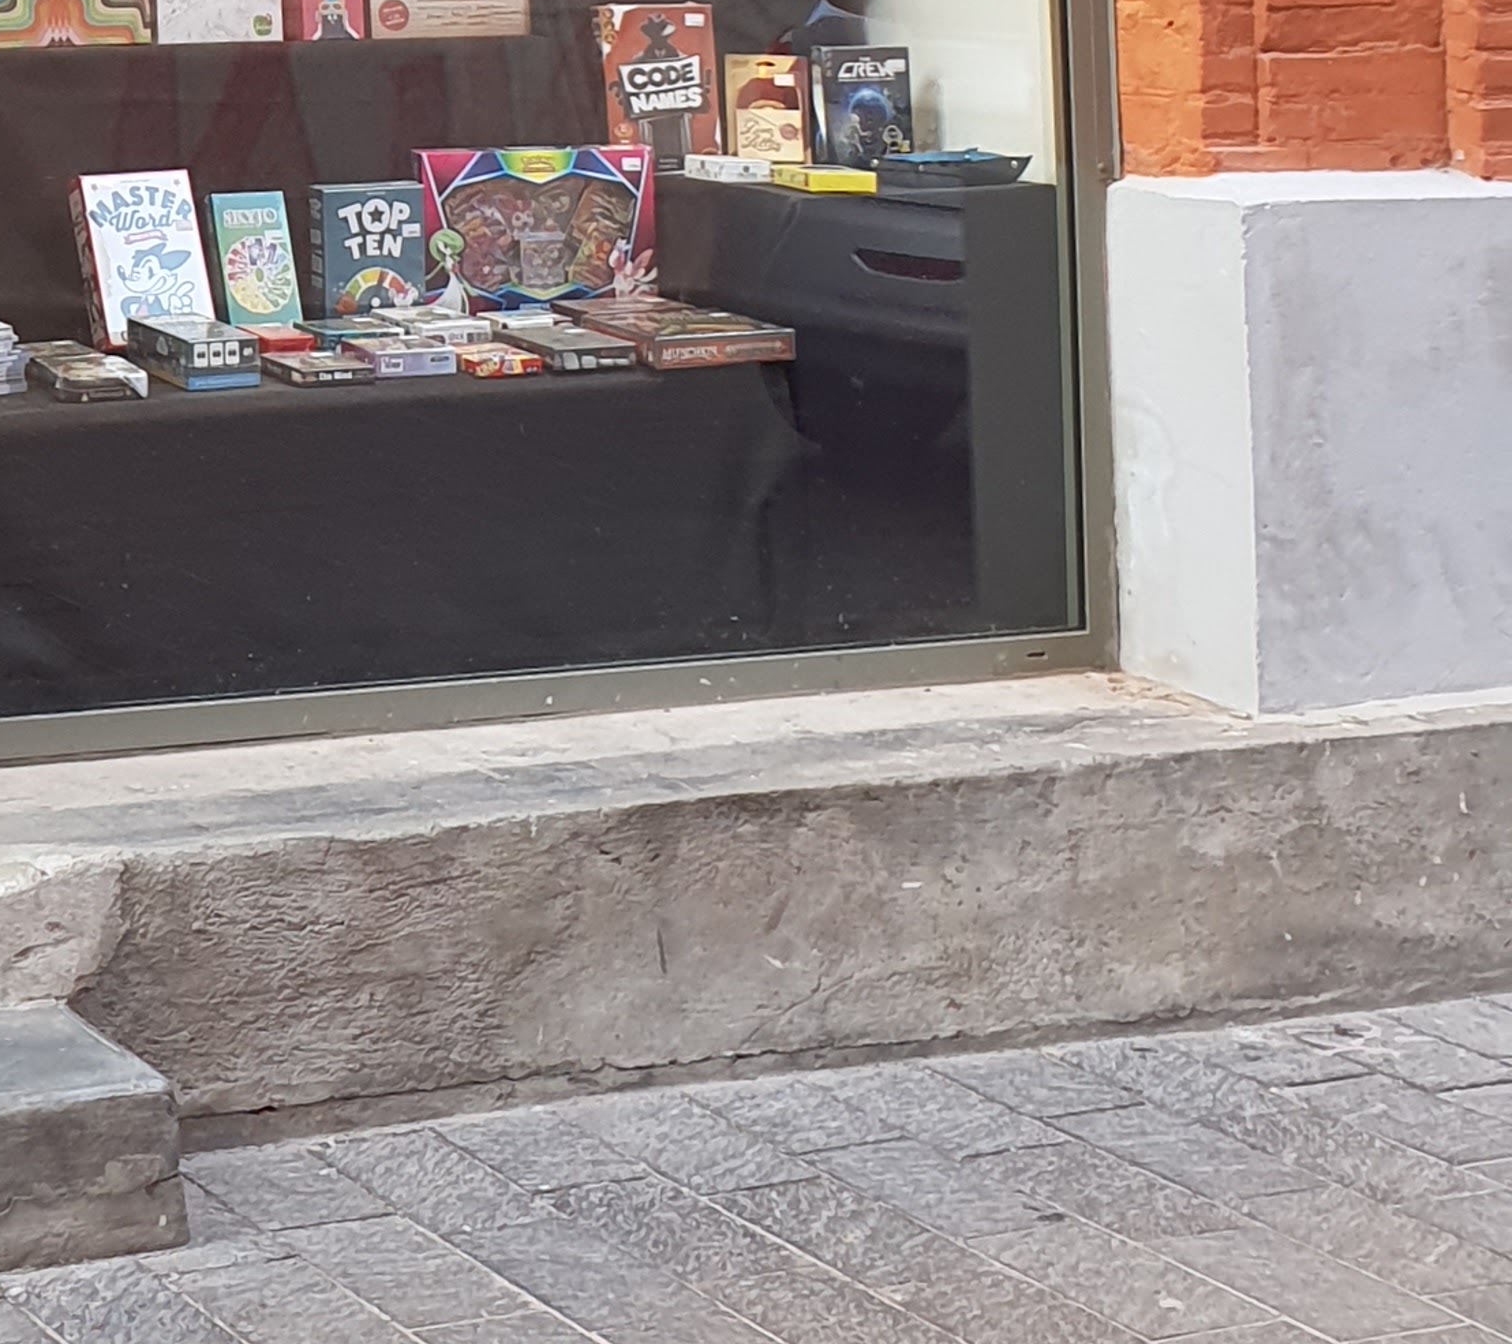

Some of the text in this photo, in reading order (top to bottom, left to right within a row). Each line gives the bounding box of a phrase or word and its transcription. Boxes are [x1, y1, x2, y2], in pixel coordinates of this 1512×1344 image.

[627, 62, 696, 91] CODE
[629, 86, 703, 114] NAMES
[88, 185, 193, 228] MASTER
[109, 209, 174, 232] Word
[338, 198, 411, 234] TOP
[343, 234, 403, 261] TEN
